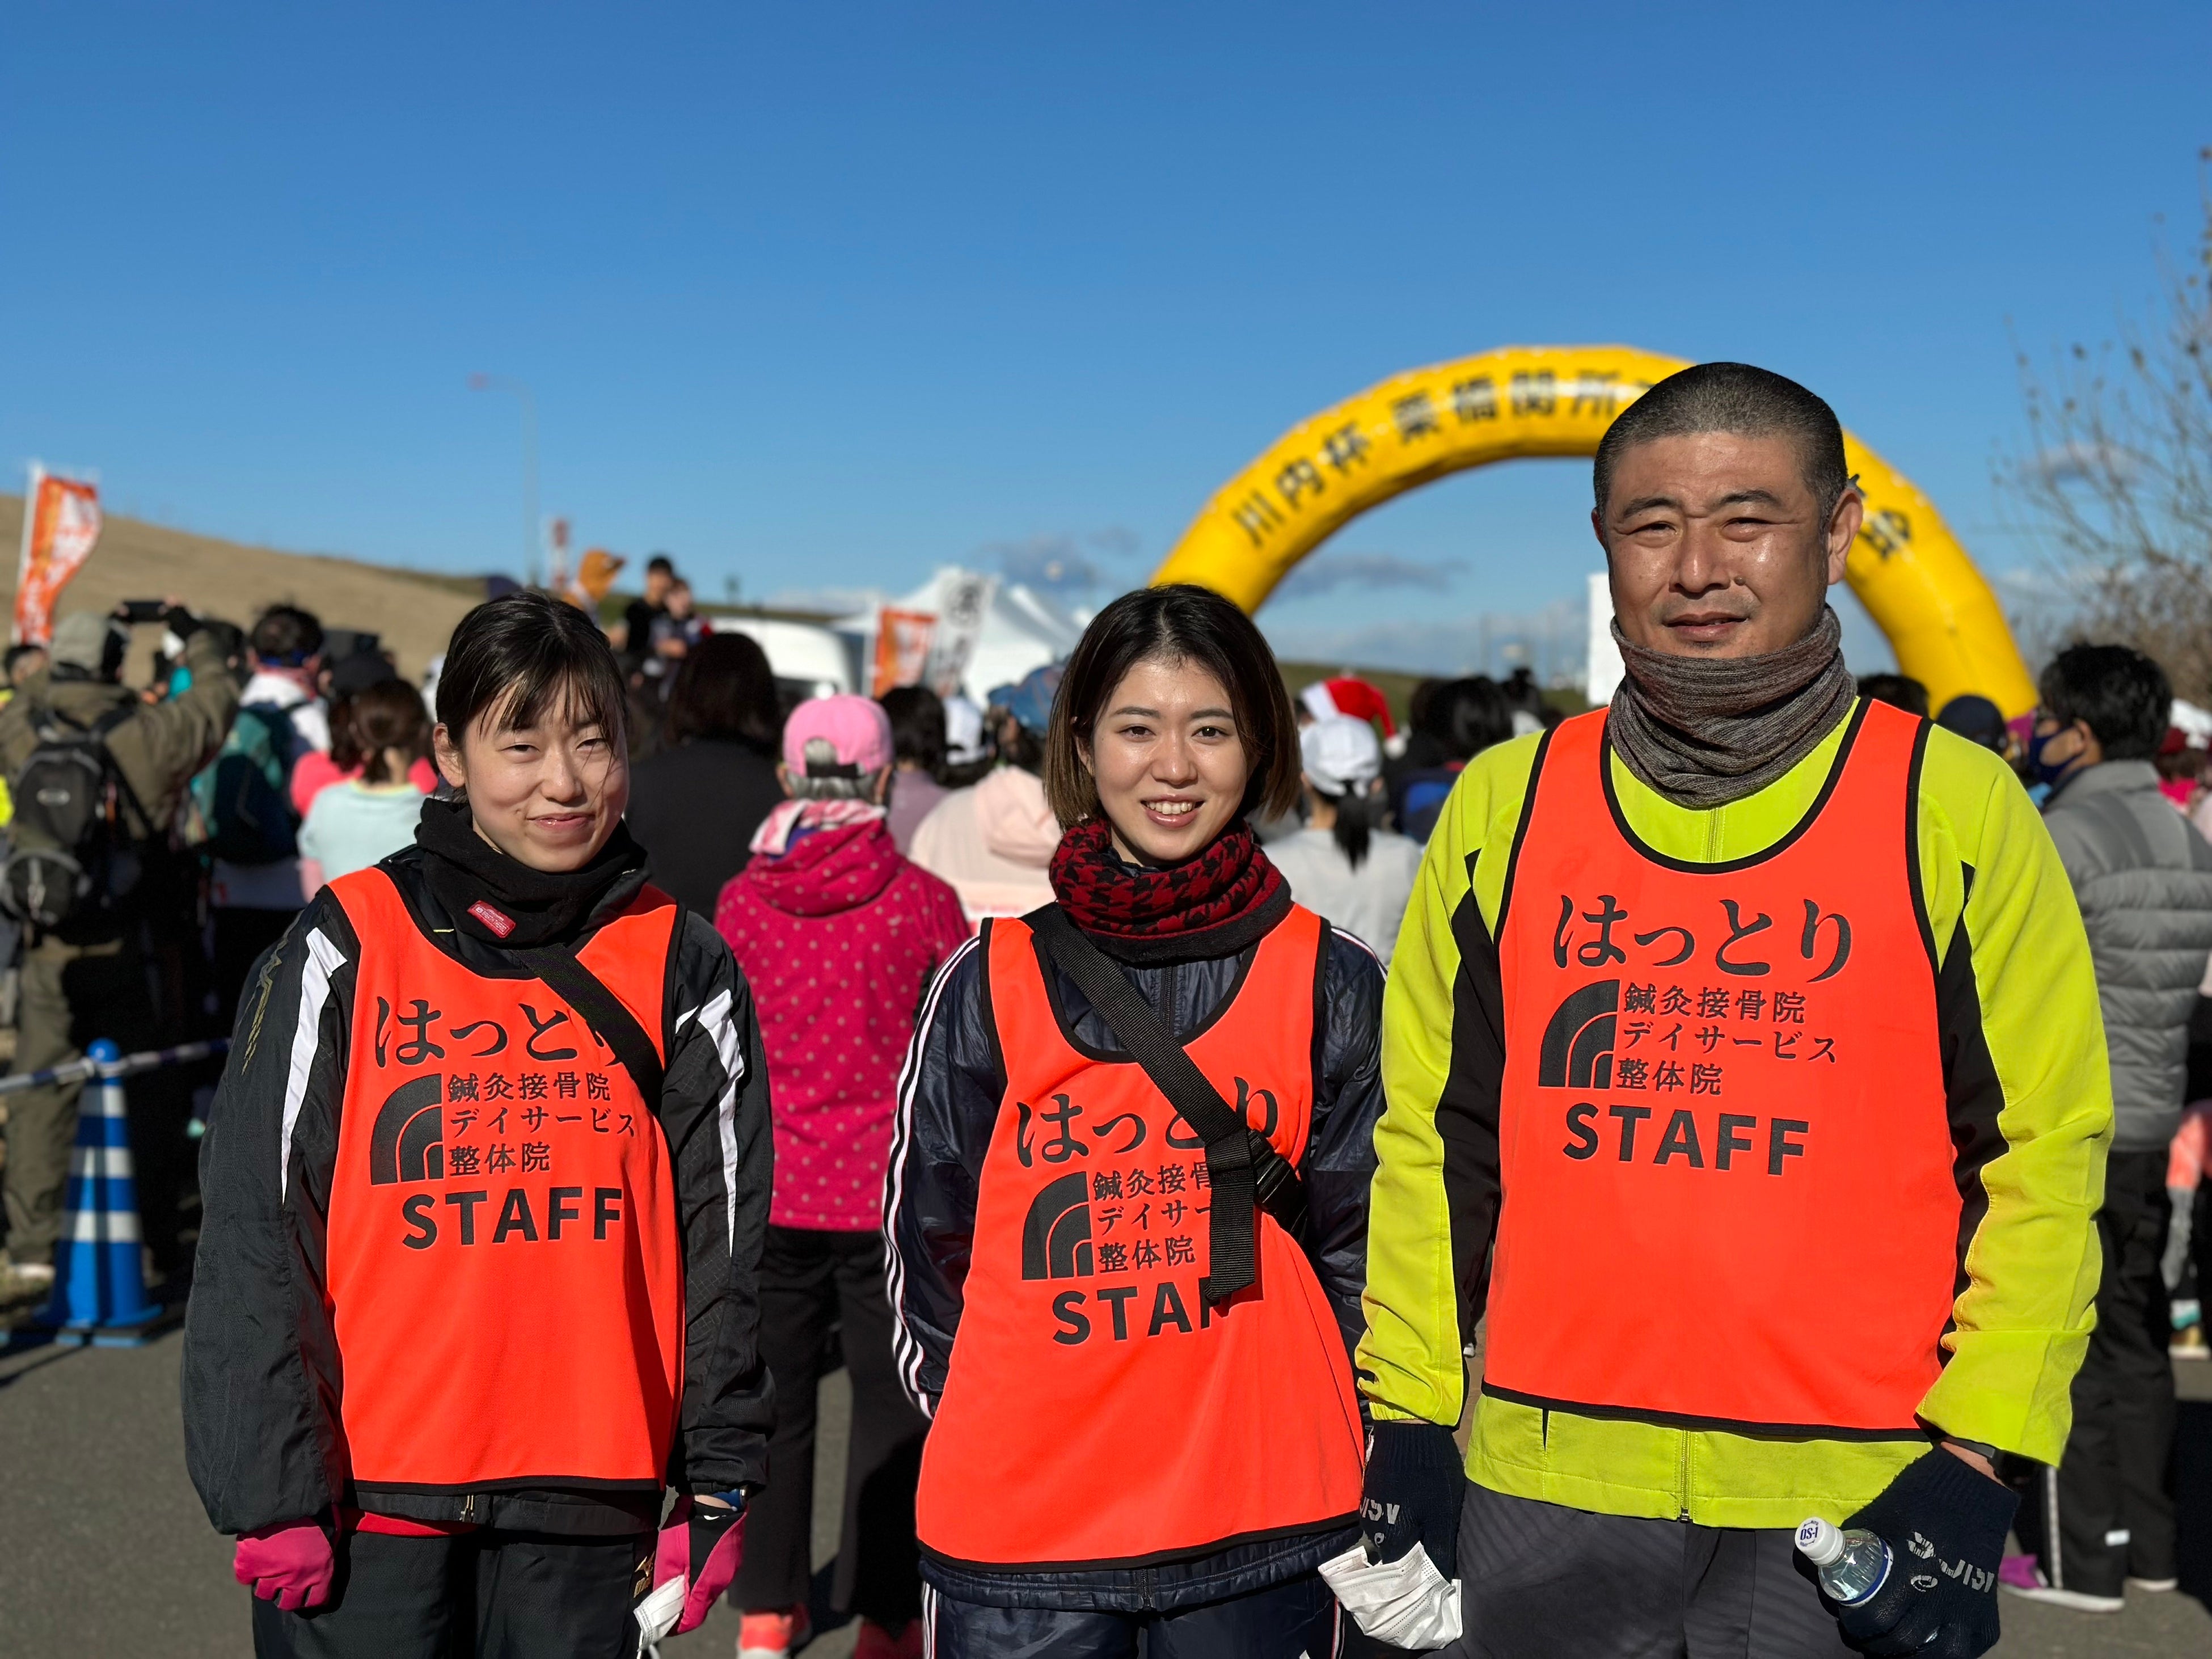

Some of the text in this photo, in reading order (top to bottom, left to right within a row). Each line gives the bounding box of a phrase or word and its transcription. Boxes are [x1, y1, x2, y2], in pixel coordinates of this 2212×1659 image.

[1553, 894, 1852, 982] はっとり
[1624, 982, 1806, 1024] 鍼灸接骨院
[1624, 1021, 1835, 1063] デイサービス
[448, 1071, 611, 1103] 鍼灸接骨院
[1616, 1057, 1723, 1096] 整体院
[450, 1107, 634, 1138] デイサービス
[1563, 1102, 1809, 1176] STAFF
[449, 1141, 551, 1177] 整体院
[402, 1187, 623, 1249] STAFF
[1097, 1235, 1196, 1274] 整体院
[1800, 1526, 1818, 1540] OS-1
